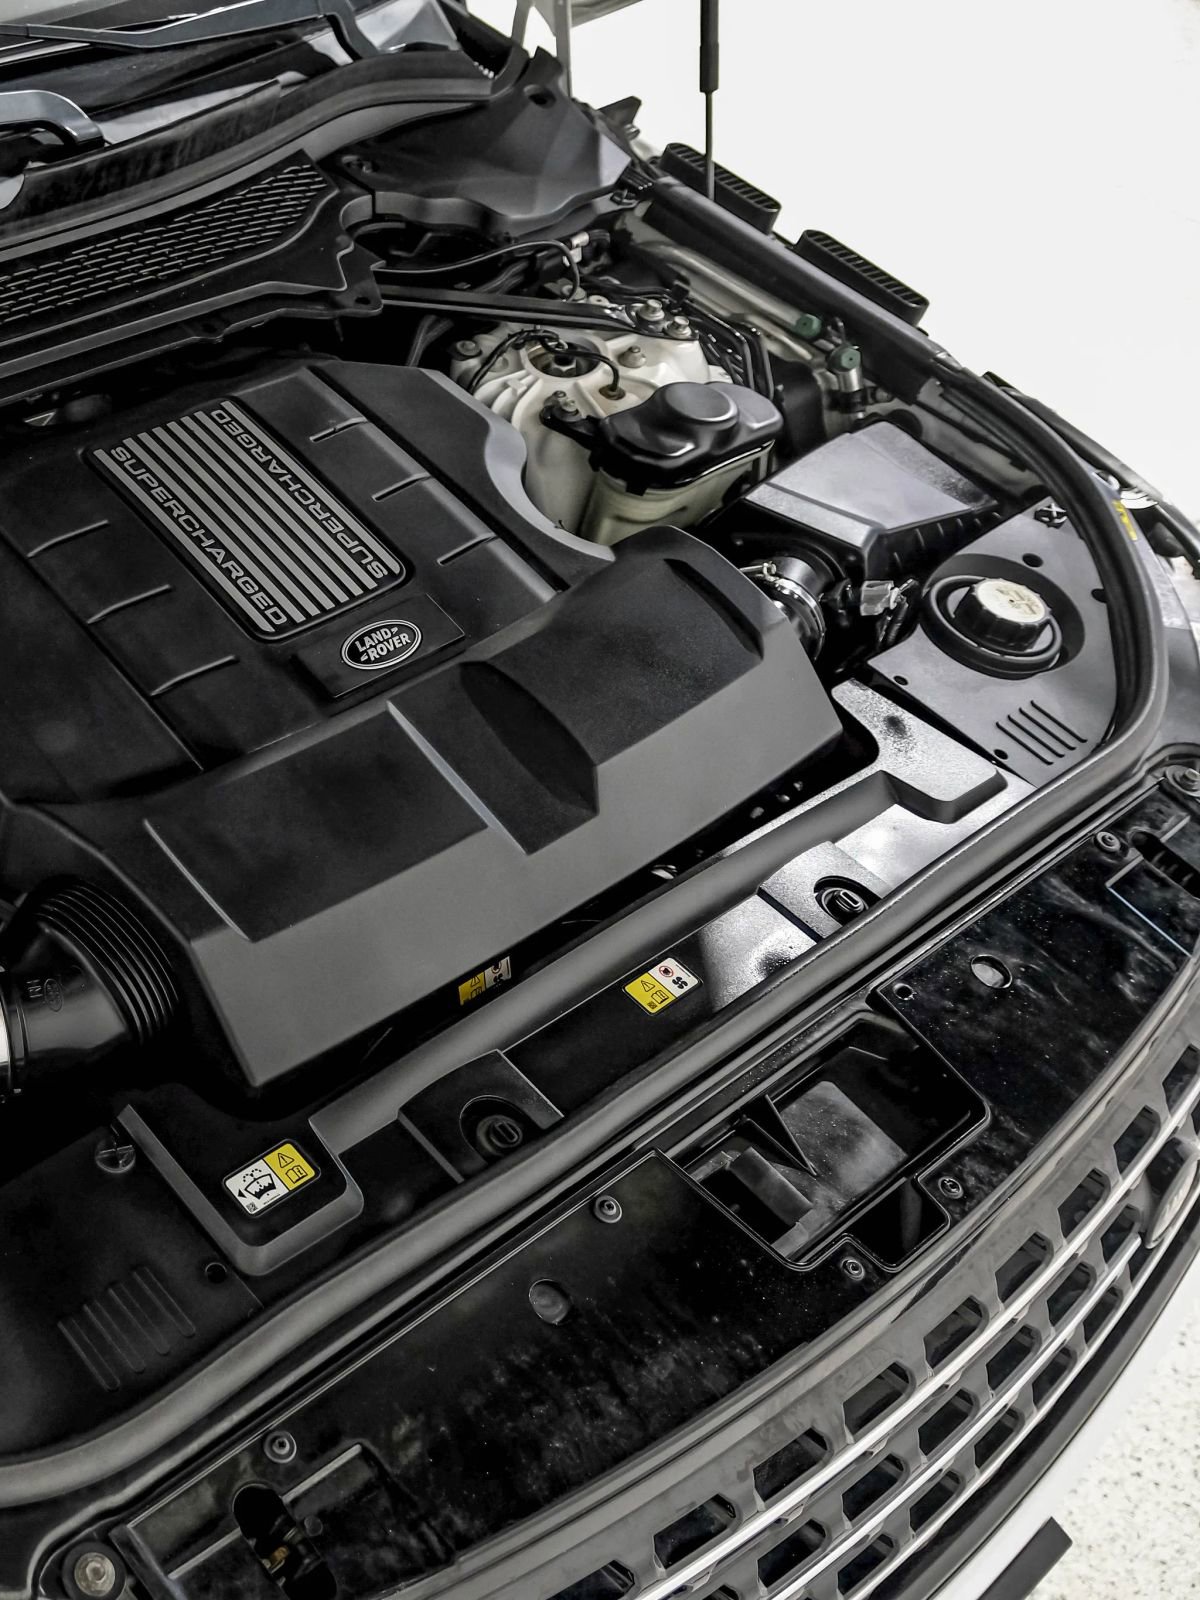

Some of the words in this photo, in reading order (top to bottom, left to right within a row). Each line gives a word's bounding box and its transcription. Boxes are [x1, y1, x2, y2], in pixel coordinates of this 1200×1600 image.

[110, 447, 287, 626] SUPERCHARGED
[210, 409, 388, 579] SUPERCHARGED
[354, 627, 393, 652] LAND
[366, 632, 411, 661] ROVER
